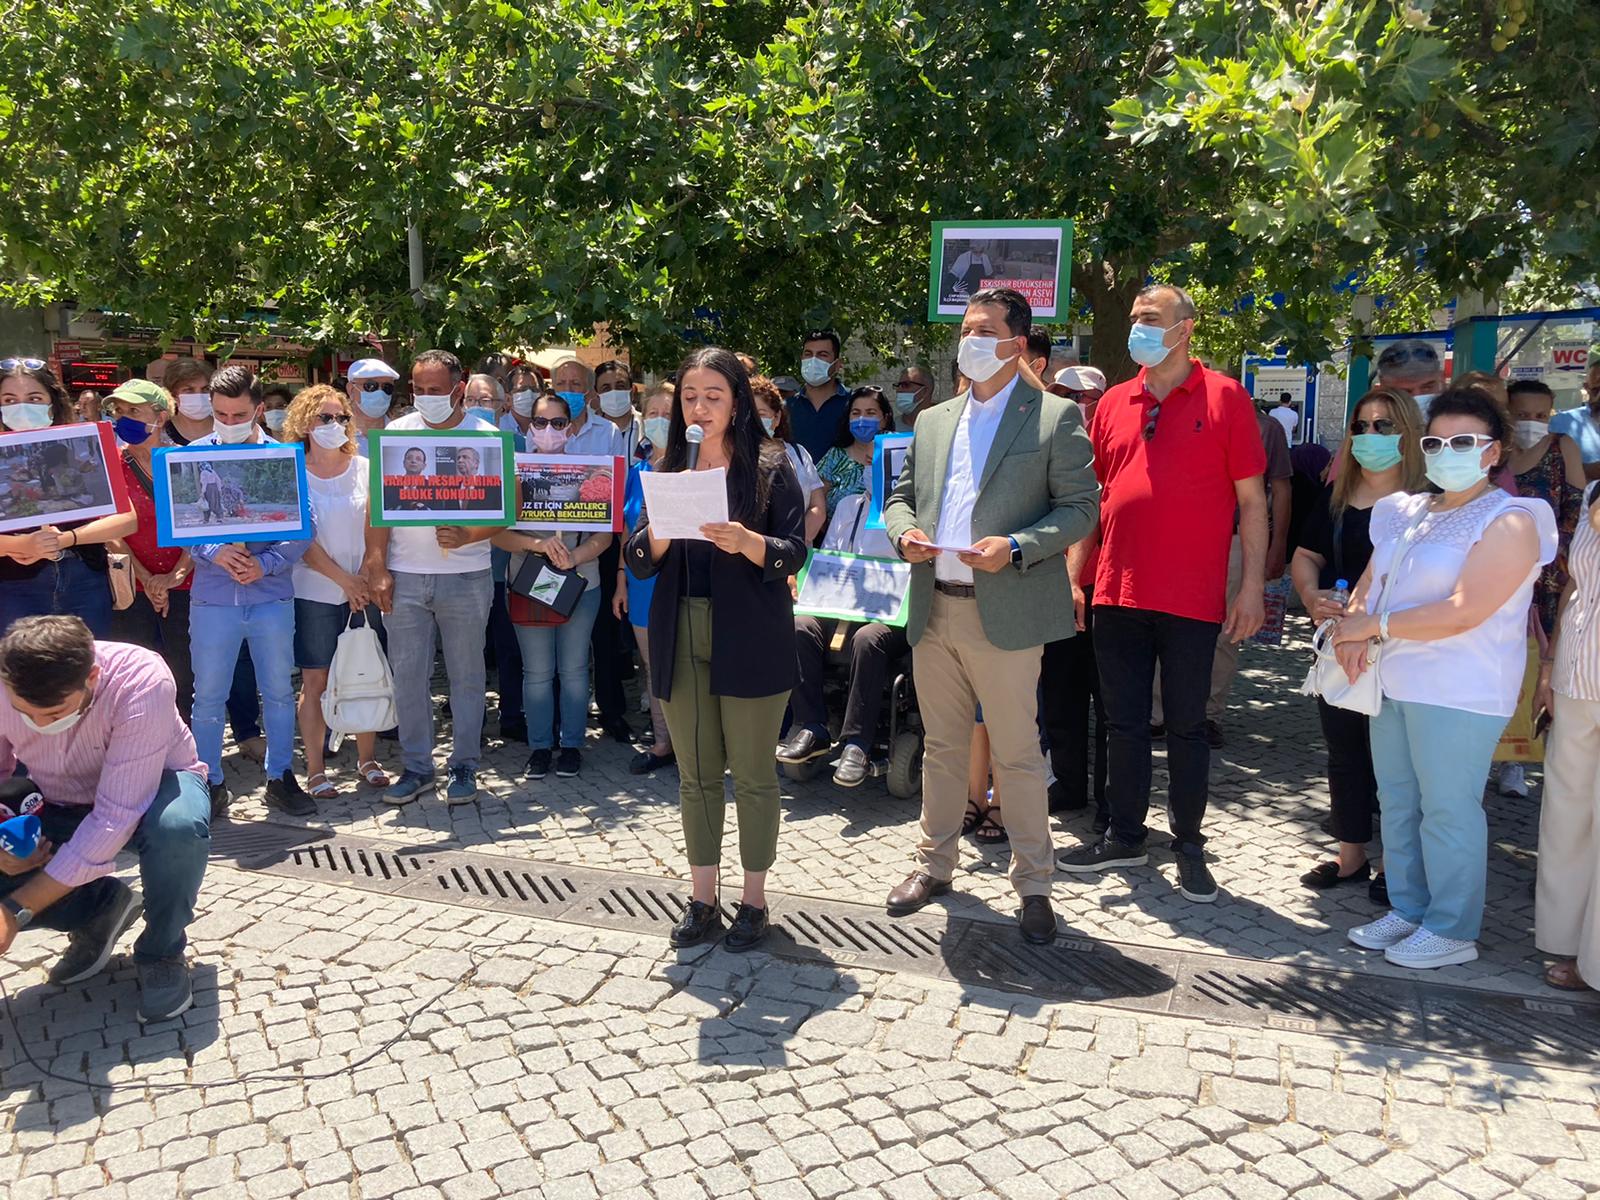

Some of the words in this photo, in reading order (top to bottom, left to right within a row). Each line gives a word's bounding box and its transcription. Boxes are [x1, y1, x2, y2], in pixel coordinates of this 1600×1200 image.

[1012, 279, 1053, 289] BÜYÜKŞEHİR
[1552, 349, 1588, 364] WC
[399, 488, 433, 500] BLOKE
[436, 488, 486, 500] KONULDU
[534, 502, 543, 510] ET
[545, 500, 562, 511] İÇİN
[563, 502, 607, 510] SAATLERCE
[557, 509, 606, 519] BEKLEDİLER!
